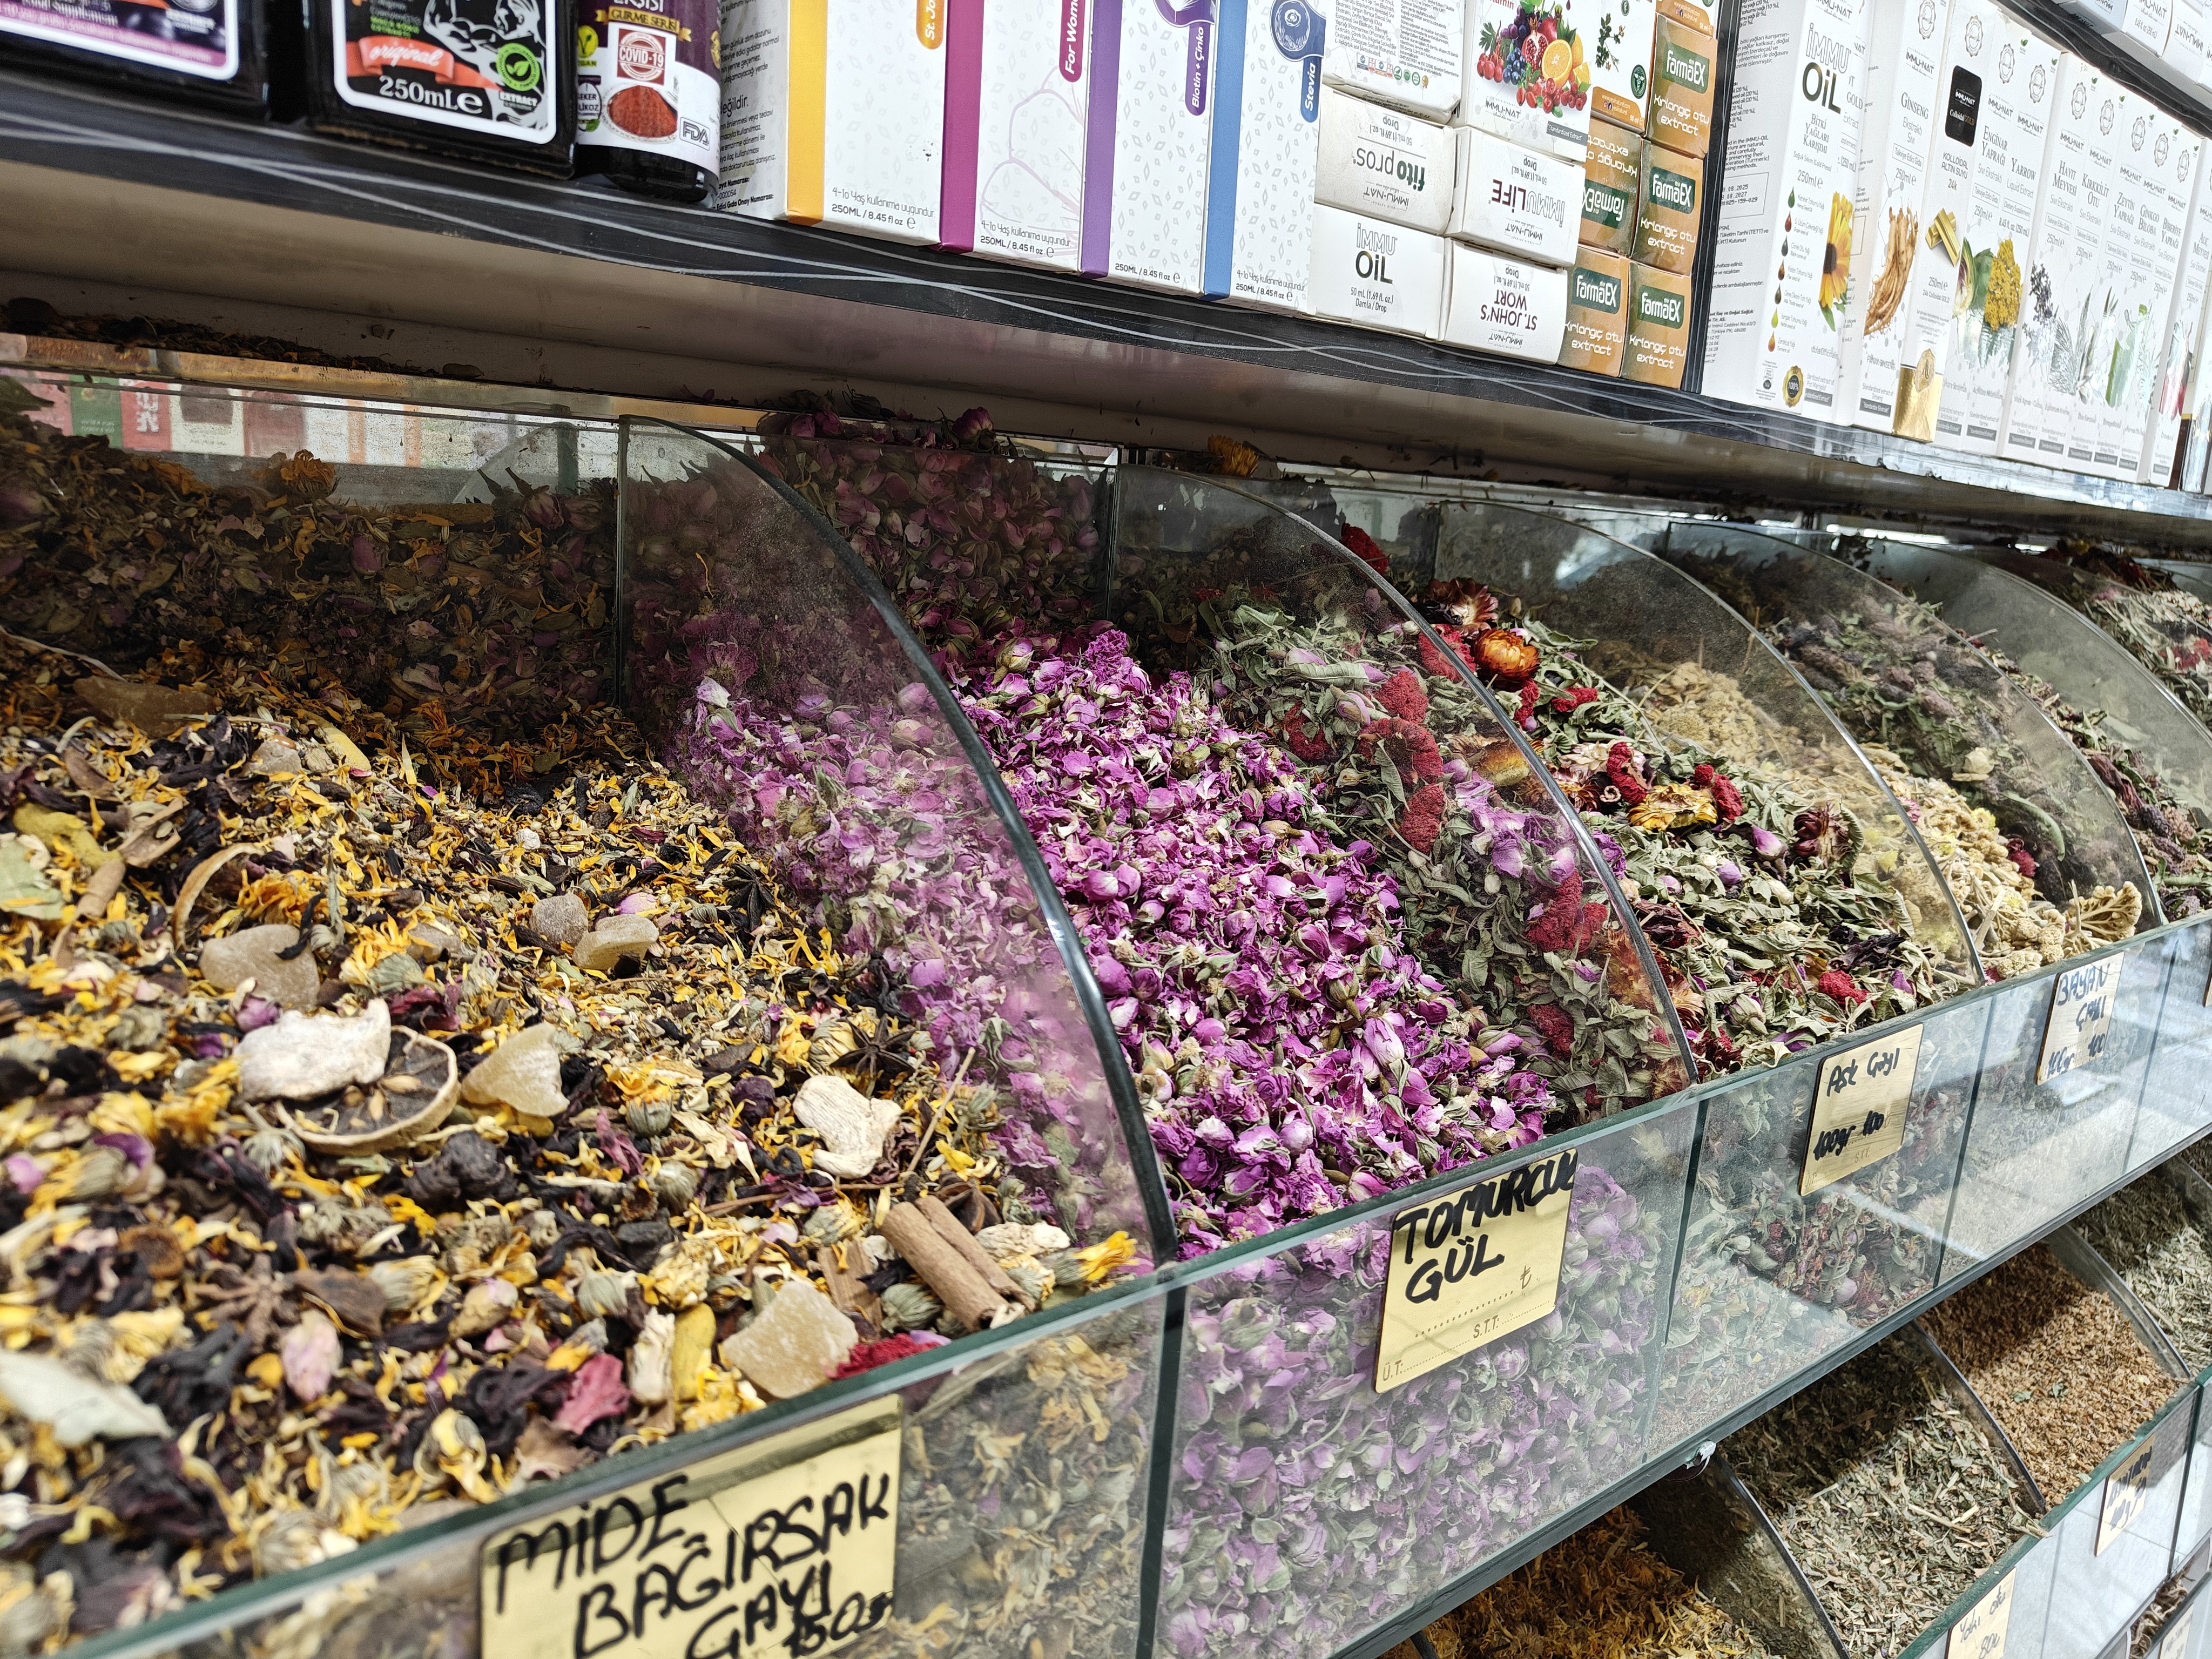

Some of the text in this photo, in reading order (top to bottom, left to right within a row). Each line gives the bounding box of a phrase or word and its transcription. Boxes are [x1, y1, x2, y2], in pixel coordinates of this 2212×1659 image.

[611, 9, 648, 25] GURME
[925, 23, 935, 41] St.
[370, 38, 443, 67] original
[619, 46, 664, 68] COVID-19
[1065, 44, 1076, 75] For
[1192, 26, 1205, 108] Biotin Çinko
[1305, 63, 1316, 111] Stevia
[500, 91, 537, 107] EXTRACT
[1846, 91, 1864, 110] GOLD
[1382, 115, 1399, 131] Drop
[1661, 115, 1699, 136] extract
[1693, 111, 1710, 126] otu
[683, 121, 710, 146] FDA
[1406, 136, 1412, 146] 50
[1805, 123, 1830, 143] YAĞLARI
[1983, 125, 2008, 152] ENGİNAR
[1981, 140, 2006, 166] YAPRAĞI
[1523, 157, 1537, 171] Drop
[1941, 162, 1968, 179] ALTIN SUYU
[2011, 157, 2036, 181] YARROW
[1542, 177, 1547, 185] 50
[1797, 169, 1816, 187] 250ml
[1896, 167, 1912, 184] 250ml
[867, 194, 900, 210] kullanıma
[2087, 191, 2100, 208] OTU
[832, 204, 861, 217] 250ML
[868, 211, 886, 222] 8.45
[887, 215, 893, 224] fl
[1011, 226, 1040, 241] kullanıma
[1680, 228, 1696, 243] otu
[980, 235, 1006, 247] 250ML
[1012, 242, 1028, 252] 8.45
[1648, 237, 1685, 255] extract
[1115, 263, 1138, 274] 250ML
[1143, 268, 1158, 278] 8.45
[1158, 271, 1163, 279] fl
[1506, 266, 1519, 279] Drop
[1236, 284, 1256, 293] 250ML
[1260, 288, 1274, 296] 8.45
[1351, 287, 1357, 296] 50
[1358, 288, 1366, 298] mL
[1366, 289, 1378, 301] (1.69
[1525, 283, 1529, 292] 50
[1355, 298, 1387, 314] Damla Drop
[1494, 289, 1527, 311] WORT
[1480, 304, 1538, 331] ST. JOHN'S
[1605, 330, 1623, 343] otu
[1571, 339, 1612, 356] extract
[1668, 346, 1685, 358] otu
[1636, 353, 1674, 369] extract
[1788, 380, 1799, 390] 100%
[1405, 1233, 1505, 1304] GÜL
[575, 1472, 889, 1659] BAĞIRSAK
